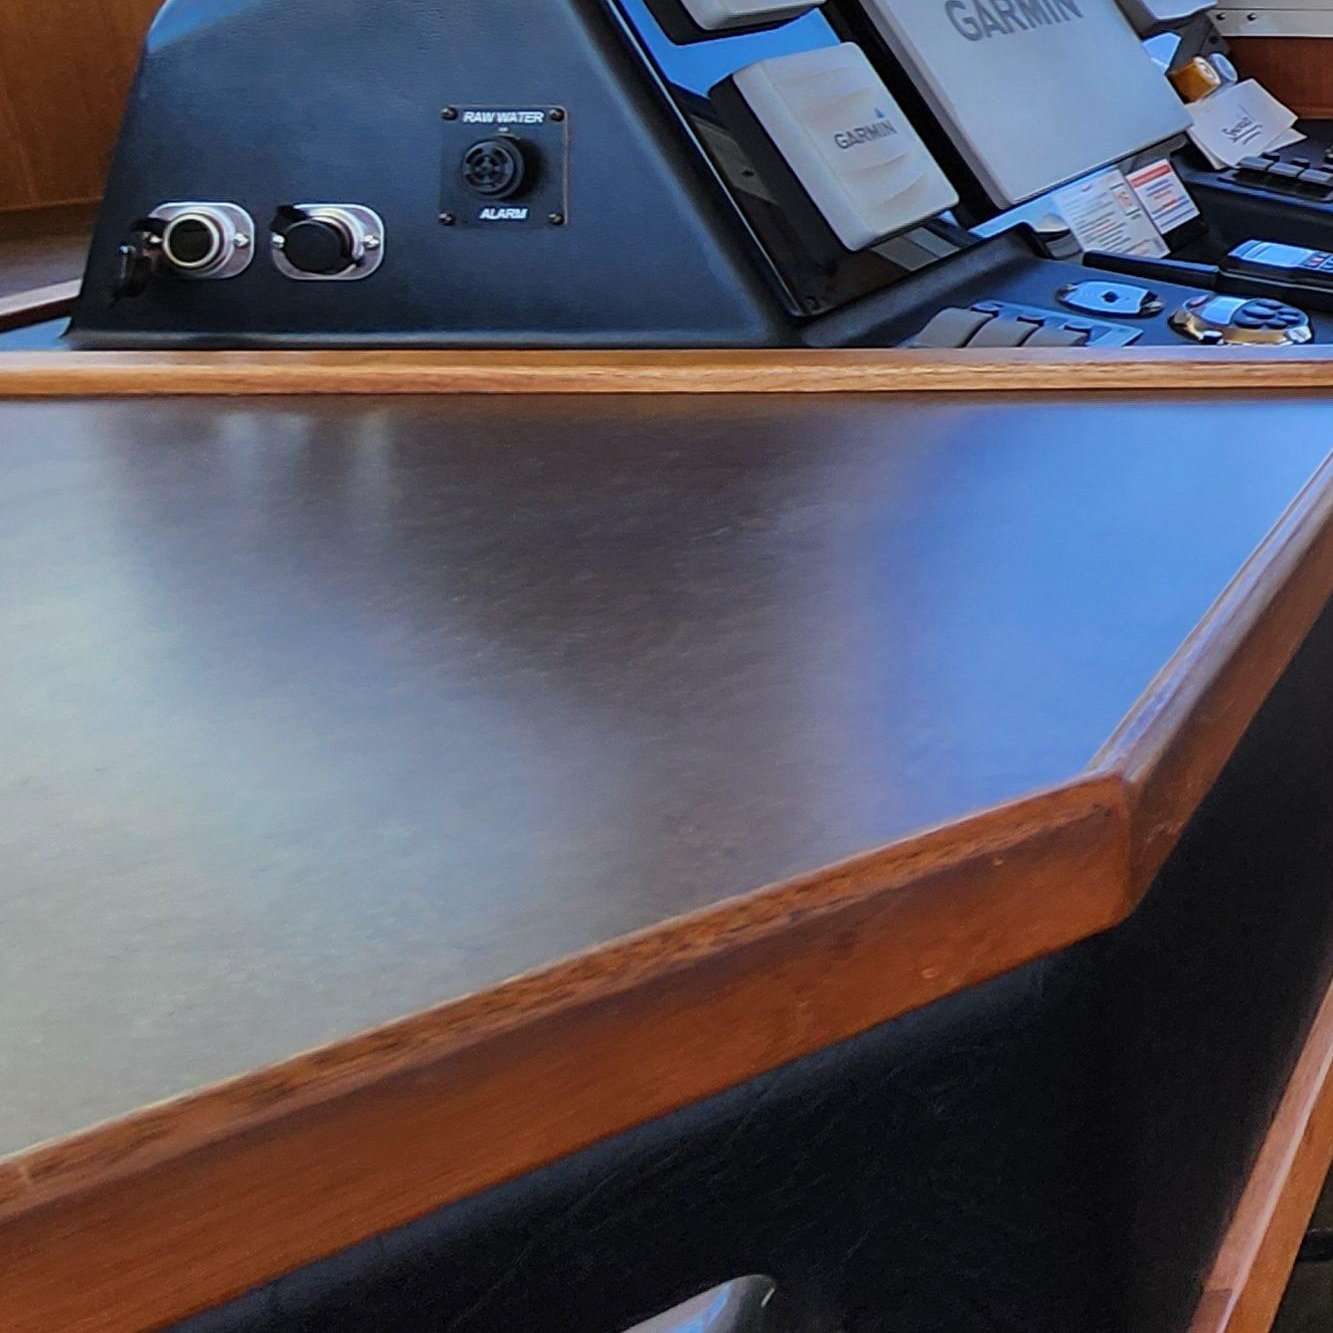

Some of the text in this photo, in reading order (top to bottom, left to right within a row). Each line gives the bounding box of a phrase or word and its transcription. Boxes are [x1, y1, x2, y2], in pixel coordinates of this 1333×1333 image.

[463, 111, 544, 123] RAW WATER
[834, 118, 895, 151] GARMIN
[479, 208, 528, 219] ALARM
